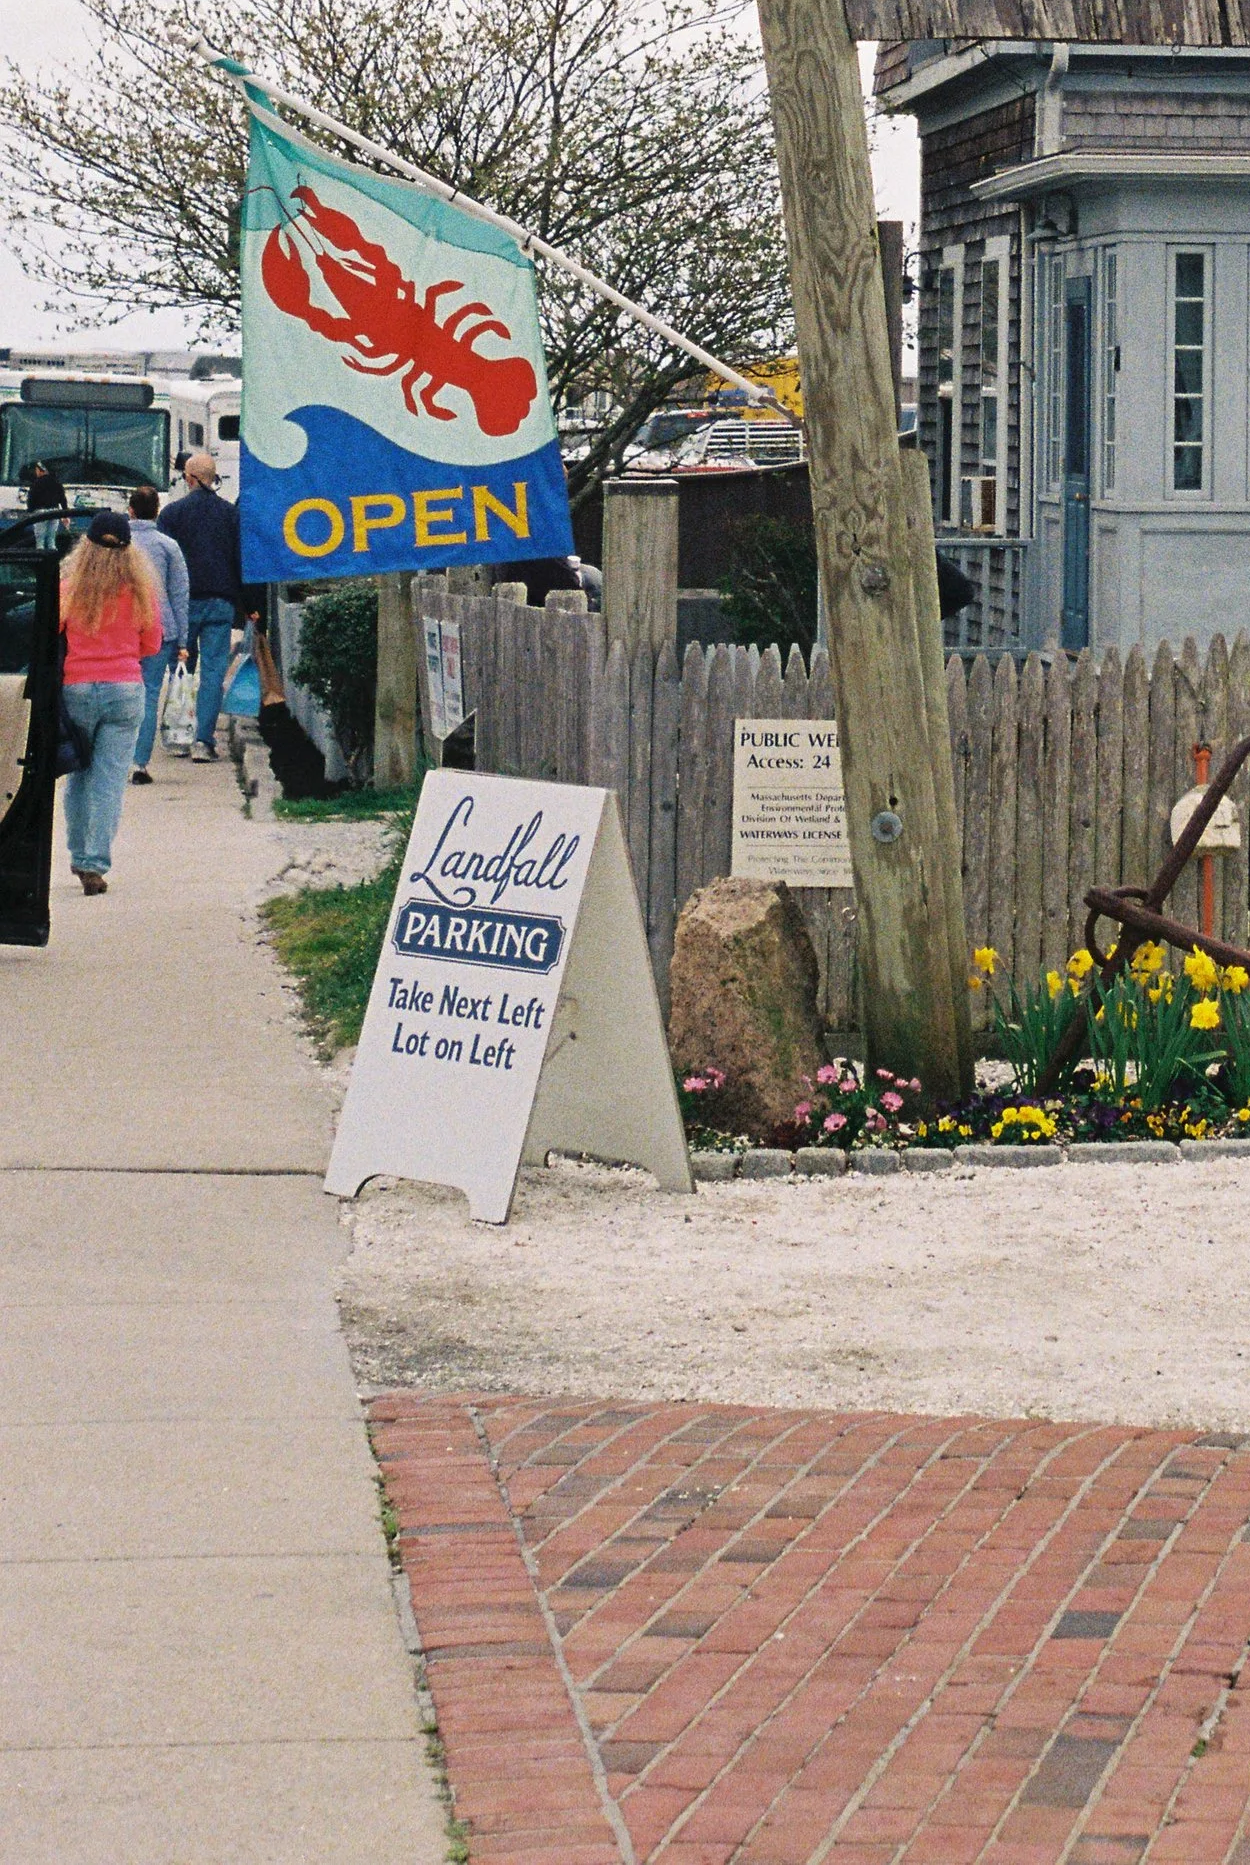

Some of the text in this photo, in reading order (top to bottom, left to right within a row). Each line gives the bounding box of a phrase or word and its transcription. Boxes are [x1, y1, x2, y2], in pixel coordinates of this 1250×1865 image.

[283, 482, 531, 558] OPEN
[740, 732, 801, 748] PUBLIC
[746, 754, 832, 769] Access: 24
[750, 792, 812, 801] Massachusetts
[739, 830, 842, 840] WATERWAYS LICENSE
[741, 815, 776, 824] Division
[409, 795, 580, 908] Landfall
[402, 911, 549, 962] PARKING
[388, 977, 545, 1029] Take Next Left
[391, 1022, 516, 1070] Lot on Left
